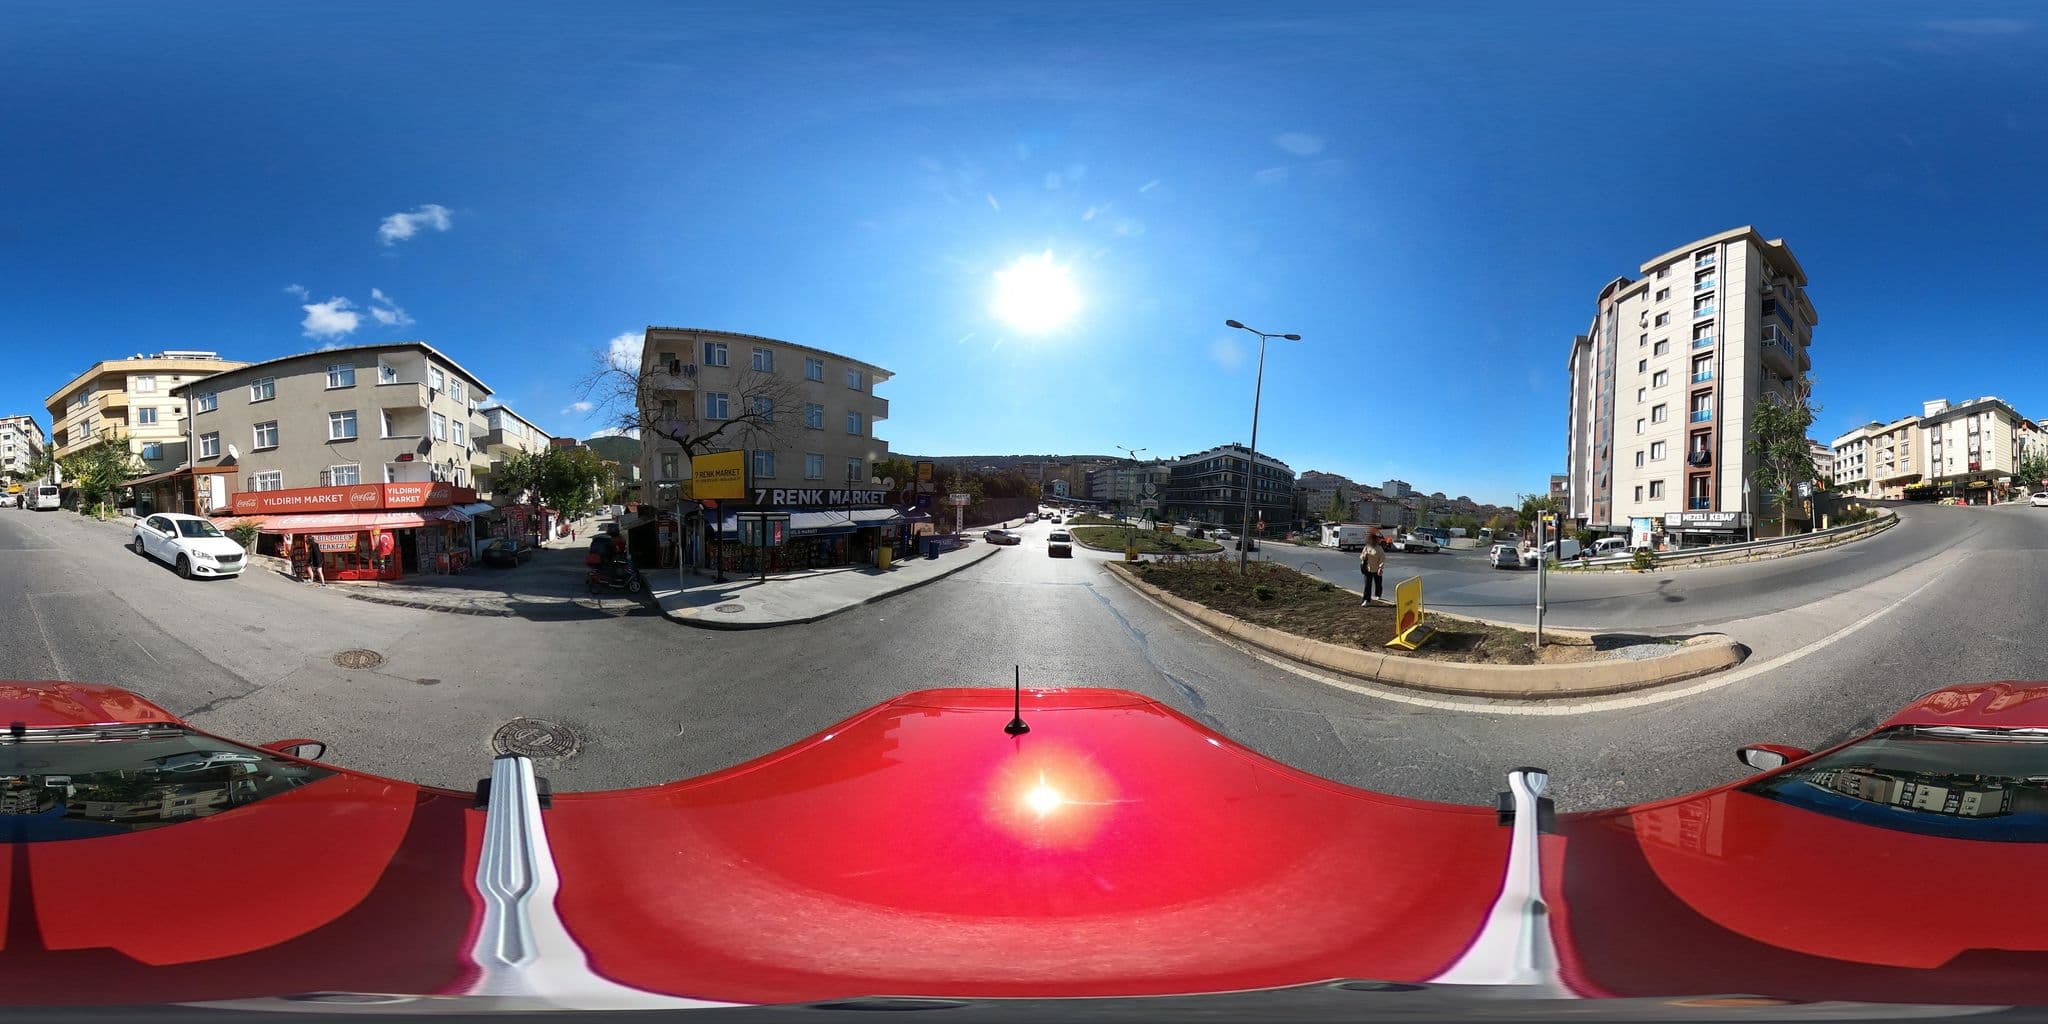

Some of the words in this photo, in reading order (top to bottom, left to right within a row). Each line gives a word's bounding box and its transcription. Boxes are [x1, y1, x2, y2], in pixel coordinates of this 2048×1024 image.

[715, 468, 741, 477] MARKET
[263, 496, 302, 506] YILDIRIM
[304, 494, 344, 503] MARKET
[388, 495, 421, 503] MARKET
[755, 489, 767, 505] 7
[773, 490, 823, 505] RENK
[828, 490, 887, 504] MARKET
[1710, 513, 1735, 521] KEBAP
